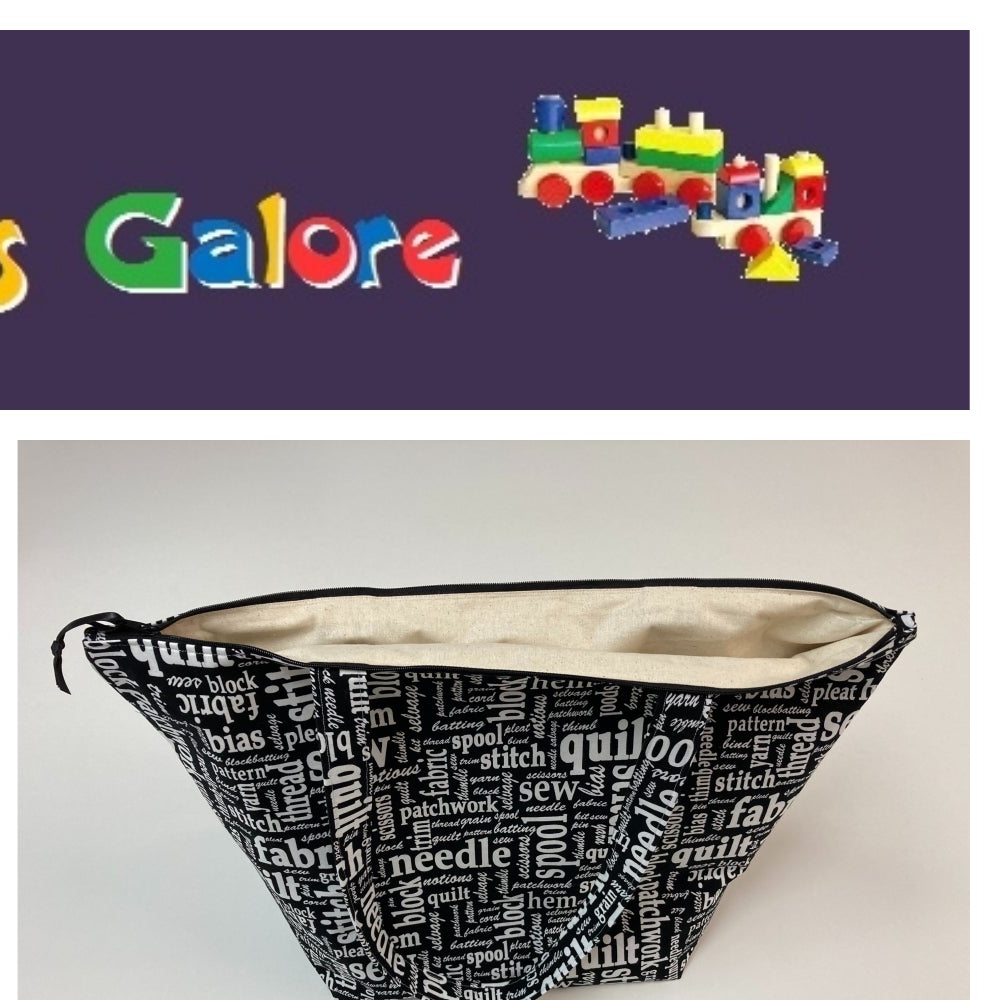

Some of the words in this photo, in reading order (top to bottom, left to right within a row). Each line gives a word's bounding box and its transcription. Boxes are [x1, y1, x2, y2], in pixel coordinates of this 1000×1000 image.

[206, 671, 258, 693] block
[812, 687, 855, 706] pleat
[728, 717, 784, 736] pattern
[481, 743, 546, 769] stitch
[776, 717, 821, 780] thread
[418, 749, 449, 796] fabric
[715, 769, 775, 792] stitch
[267, 759, 310, 823] thread
[520, 781, 579, 801] sew
[400, 795, 498, 827] patchwork
[389, 838, 511, 877] needle
[527, 813, 580, 878] spool
[389, 877, 425, 928] block
[428, 887, 472, 909] quilt
[529, 891, 576, 908] hem
